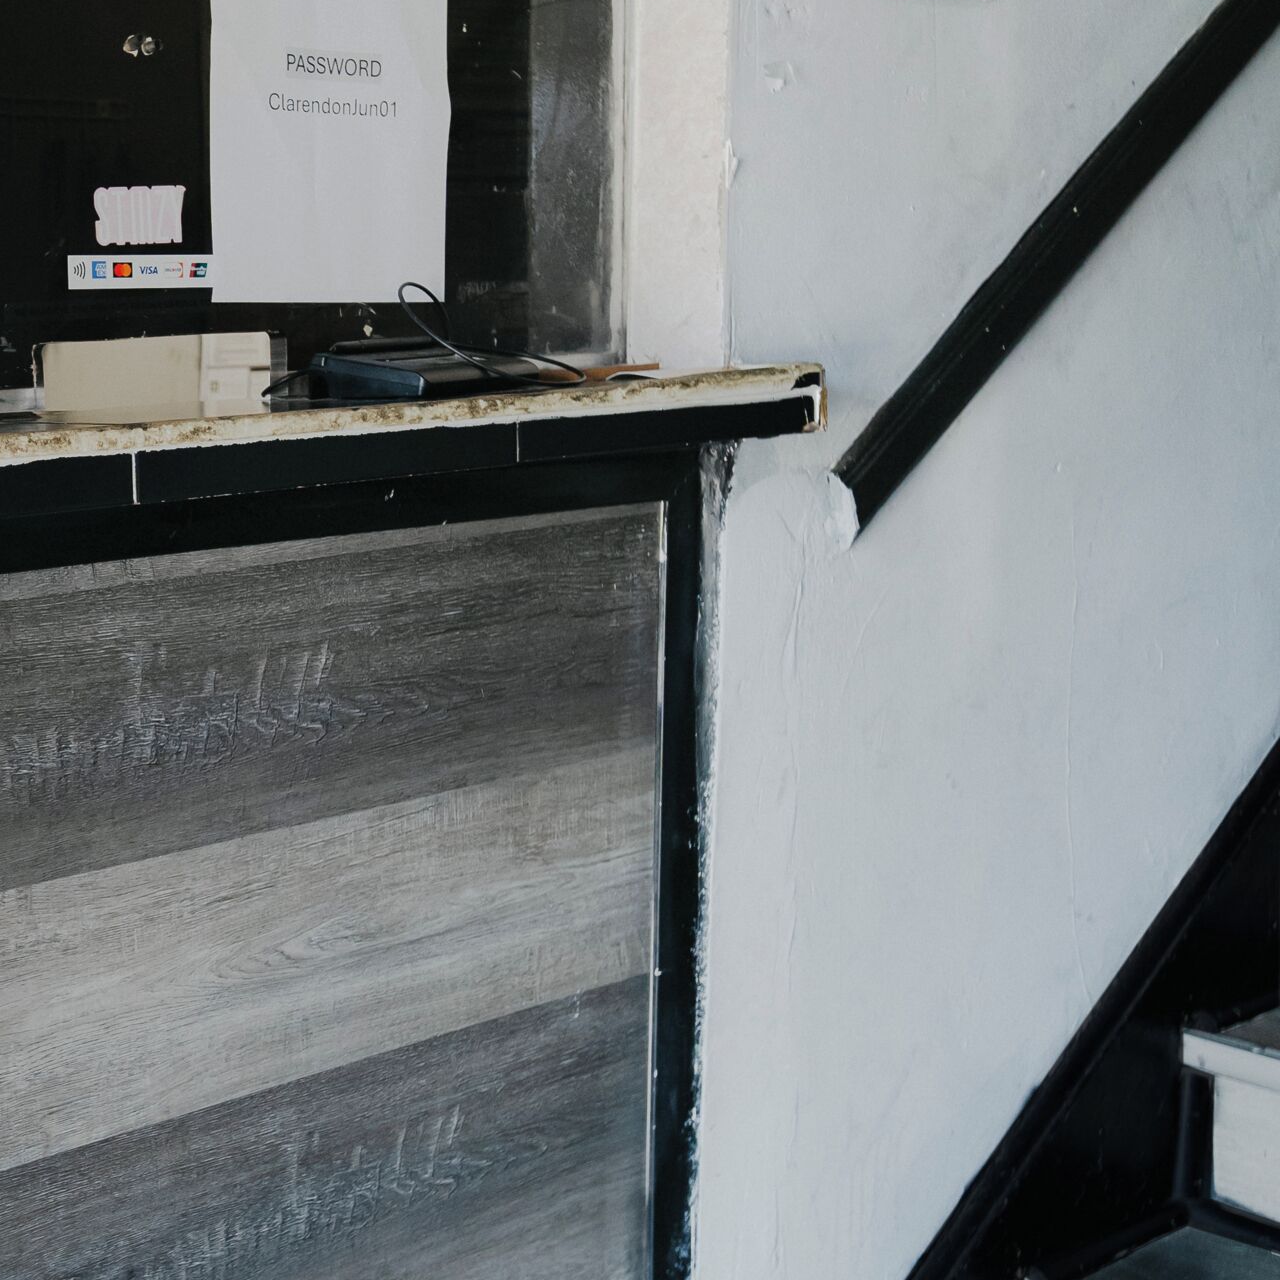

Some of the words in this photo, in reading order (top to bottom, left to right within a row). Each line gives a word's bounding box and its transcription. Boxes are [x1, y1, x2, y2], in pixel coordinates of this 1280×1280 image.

[286, 53, 382, 78] PASSWORD
[268, 92, 396, 117] ClarendonJun01
[139, 266, 159, 275] VISA
